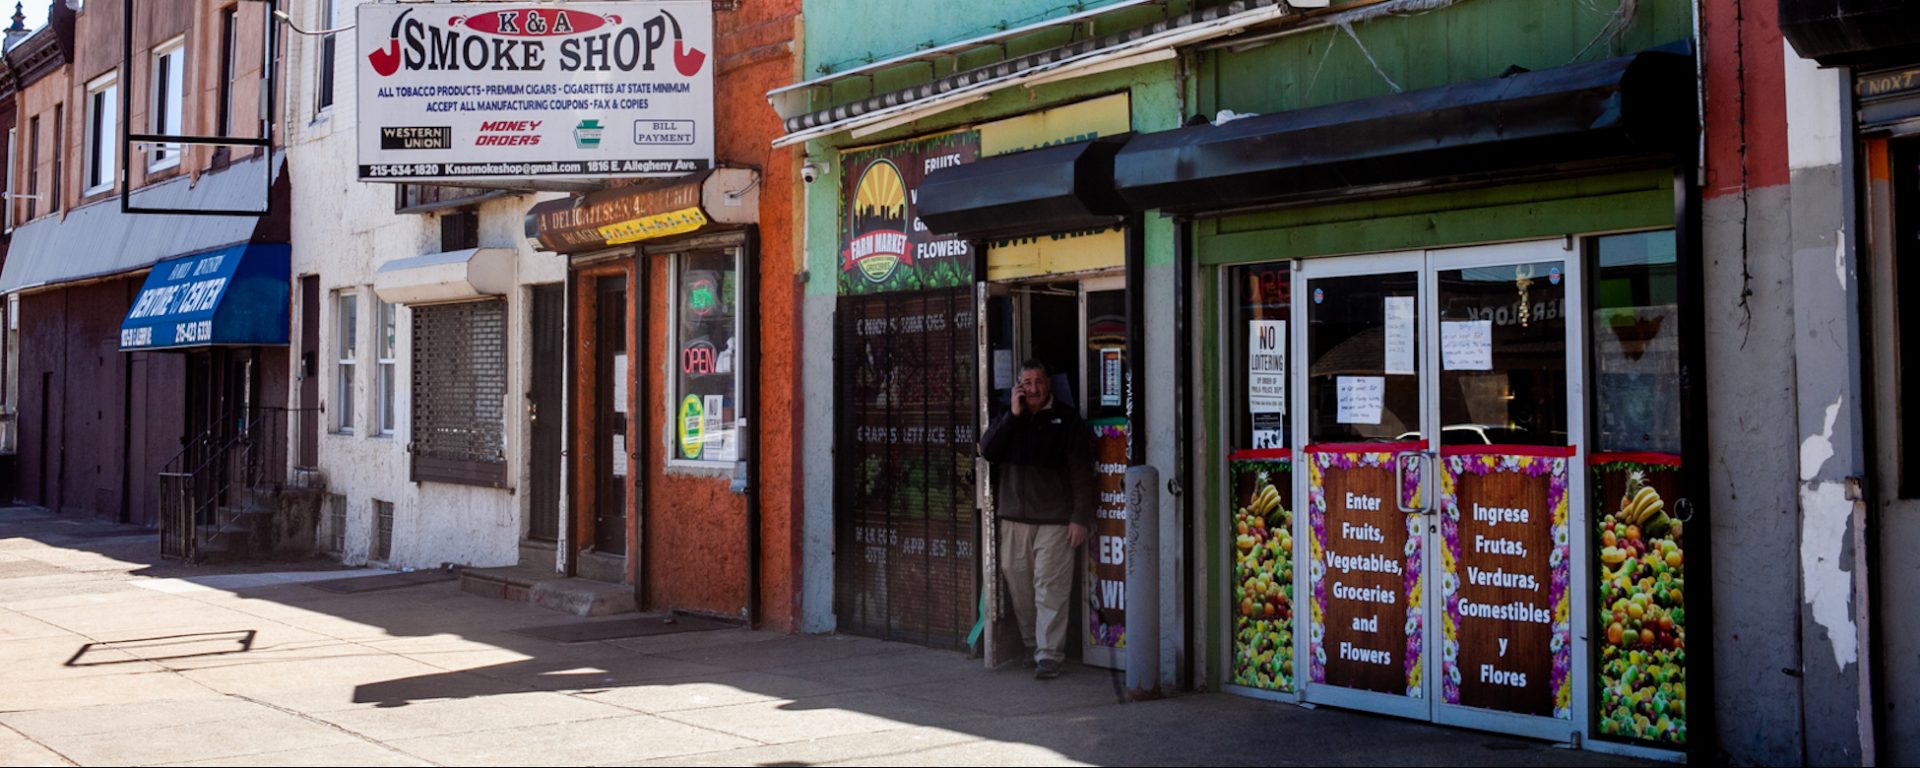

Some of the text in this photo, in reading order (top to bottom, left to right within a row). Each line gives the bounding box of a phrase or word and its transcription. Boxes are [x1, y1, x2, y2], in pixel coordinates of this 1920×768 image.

[498, 13, 572, 32] K & A
[403, 15, 666, 72] SMOKE SHOP
[378, 82, 690, 98] ALL TOBACCO PRODUCTS PREMIUM CIGARS CIGARETTES AT STATE MINIMUM
[426, 98, 649, 112] ACCEPT ALL MANUFACTURING COUPONS FAX & COPIES
[384, 128, 442, 138] WESTERN
[480, 121, 543, 132] MONEY
[653, 122, 678, 131] BILL
[404, 138, 442, 148] UNION
[475, 135, 542, 146] ORDERS
[639, 134, 692, 142] PAYMENT
[370, 160, 697, 176] 215-634-1820 Knasmokeshop@gmail.com 1816 E. Allegheny Ave.
[851, 232, 908, 261] FARM MARKET
[917, 240, 967, 260] FLOWERS
[1260, 326, 1275, 350] NO
[683, 348, 716, 375] OPEN
[1251, 354, 1283, 372] LOITERING
[1345, 492, 1381, 511] Enter
[1096, 506, 1108, 519] de
[1473, 502, 1529, 527] Ingrese
[1342, 522, 1385, 544] Fruits,
[1475, 535, 1527, 558] Frutas,
[1325, 551, 1403, 576] Vegetables,
[1467, 566, 1539, 592] Verduras,
[1333, 582, 1395, 604] Groceries
[1457, 598, 1551, 624] Gomestibles
[1352, 615, 1377, 633] and
[1339, 642, 1391, 665] Flowers
[1498, 636, 1508, 657] y
[1480, 664, 1527, 688] Flores
